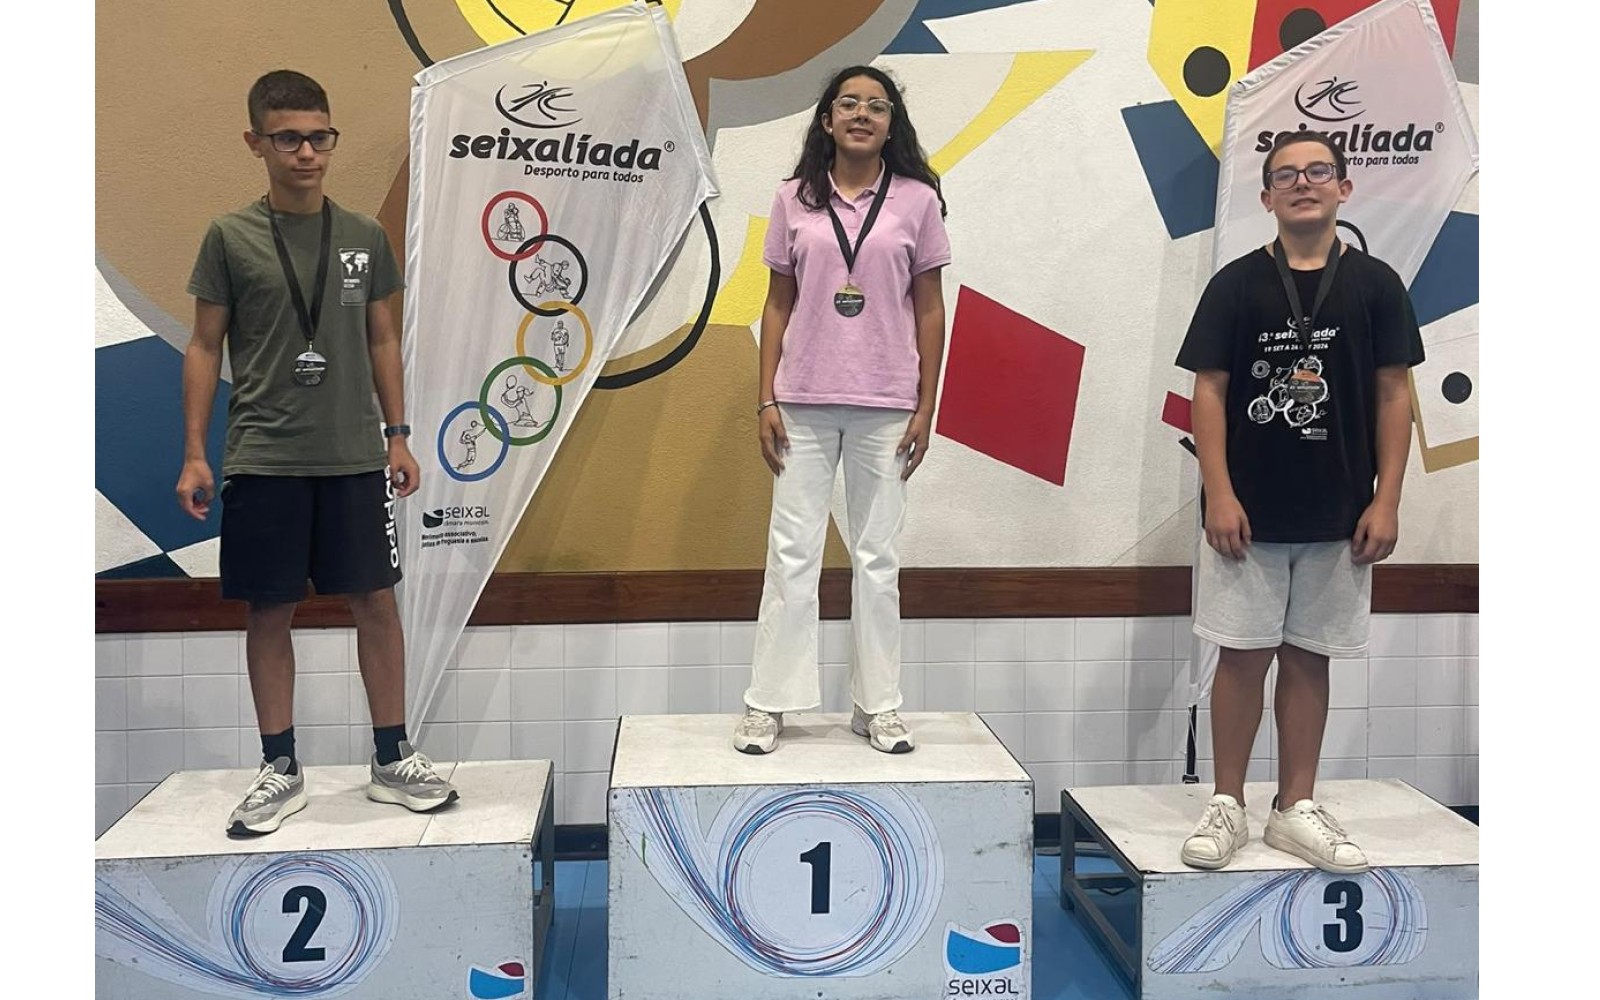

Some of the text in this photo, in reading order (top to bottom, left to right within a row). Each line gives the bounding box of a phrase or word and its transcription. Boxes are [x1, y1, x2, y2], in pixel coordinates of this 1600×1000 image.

[524, 164, 644, 183] Desporto para todos
[1365, 155, 1389, 167] para
[1392, 153, 1419, 165] todos
[1273, 344, 1284, 352] SET
[800, 841, 831, 914] 1
[281, 885, 328, 963] 2
[1323, 880, 1364, 953] 3
